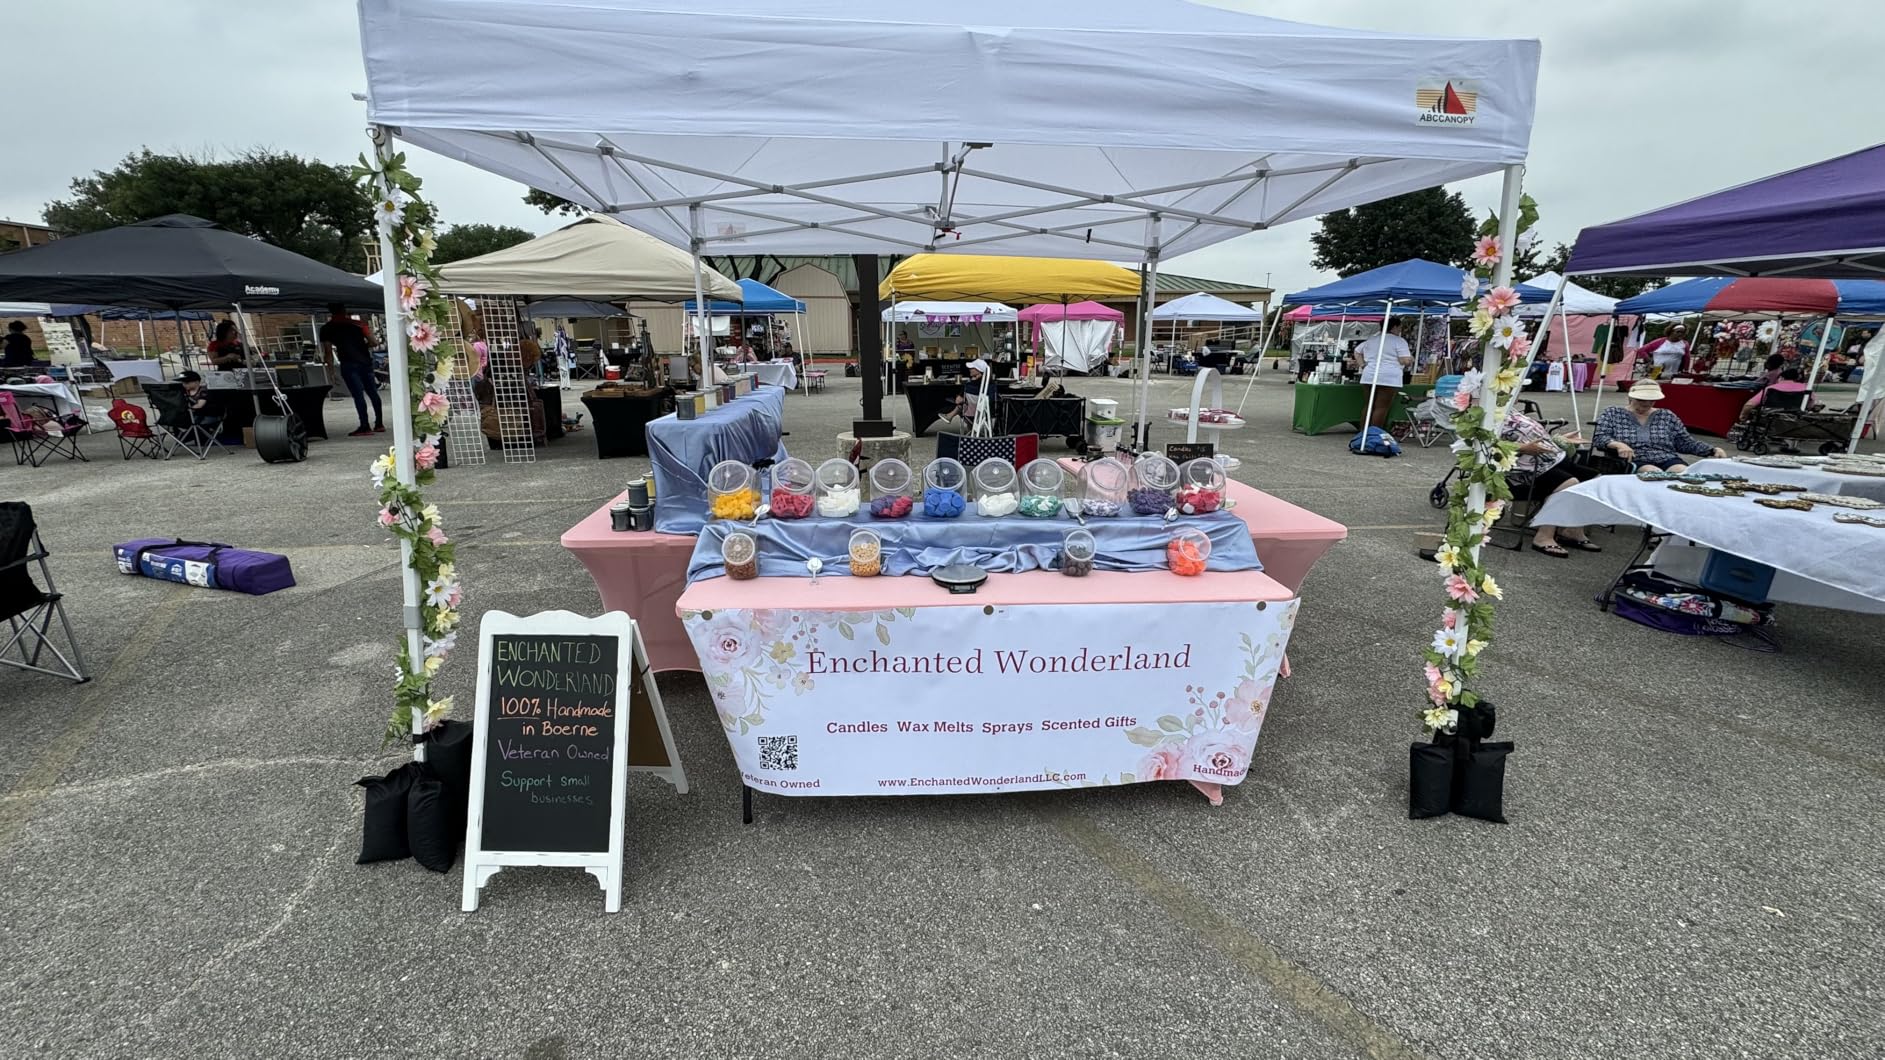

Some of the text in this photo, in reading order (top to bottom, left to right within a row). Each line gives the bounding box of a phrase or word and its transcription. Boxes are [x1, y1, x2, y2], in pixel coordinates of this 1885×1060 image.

[1419, 113, 1475, 124] ABCCANOPY
[498, 641, 601, 664] ENCHANTED
[806, 643, 1191, 674] Enchanted Wonderland
[500, 696, 614, 719] 100% Handmade
[522, 721, 599, 736] in Boerne
[826, 716, 1137, 735] Candles Wax Melts Sprays Scented Gifts
[498, 739, 609, 763] Veteran Owned
[500, 770, 590, 792] Support small
[780, 779, 820, 789] Owned
[878, 771, 1086, 787] www.EnchantedWonderlandLLC.com
[531, 792, 593, 806] businesses
